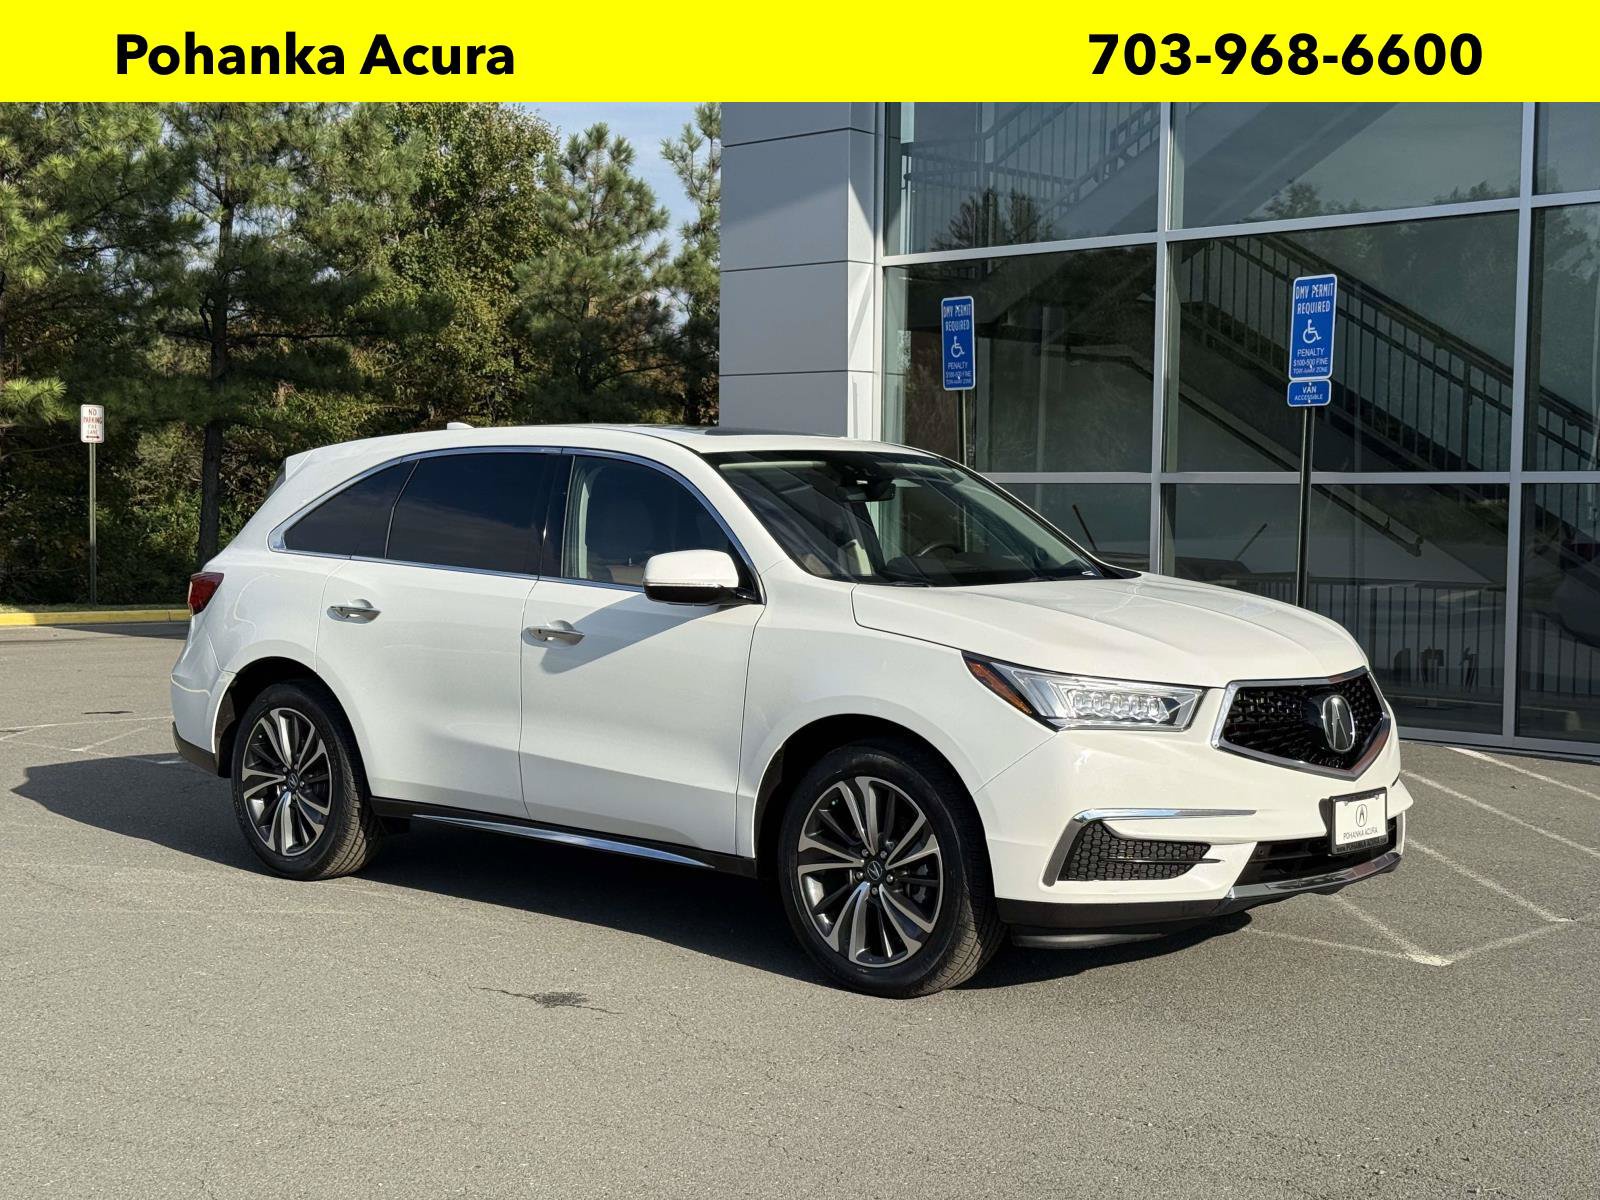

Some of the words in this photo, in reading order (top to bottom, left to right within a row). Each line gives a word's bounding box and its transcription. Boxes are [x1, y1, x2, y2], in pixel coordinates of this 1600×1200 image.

[1295, 285, 1309, 300] DMV
[1311, 282, 1334, 298] PERMIT
[943, 305, 953, 318] DMV
[955, 304, 971, 317] PERMIT
[1297, 300, 1331, 315] REQUIRED
[945, 320, 970, 331] REQUIRED
[1297, 347, 1325, 357] PENALTY
[947, 361, 968, 370] PENALTY
[1302, 385, 1317, 394] VAN
[1294, 393, 1323, 401] ACCESSIBLE
[83, 416, 102, 424] PARKING
[1343, 829, 1364, 840] POHANKA
[1364, 826, 1378, 836] ACURA
